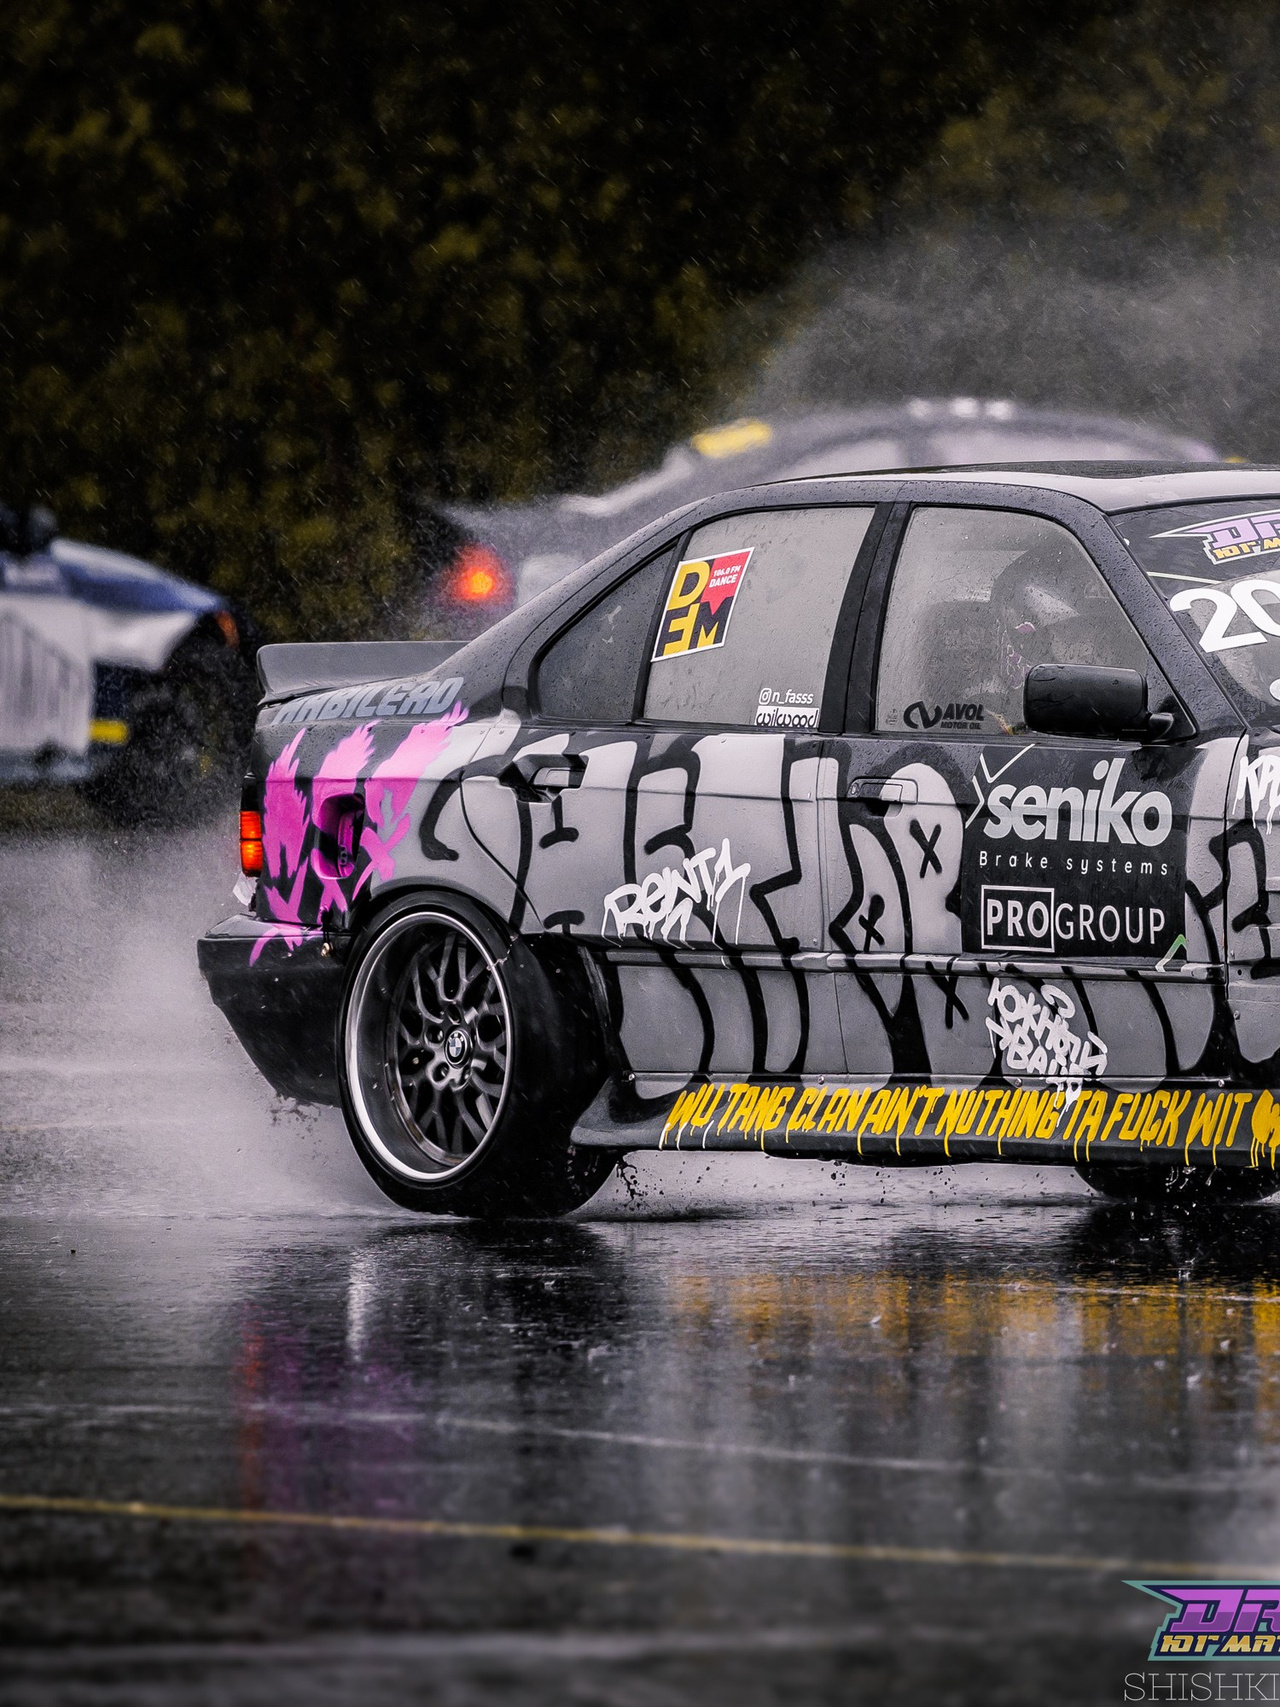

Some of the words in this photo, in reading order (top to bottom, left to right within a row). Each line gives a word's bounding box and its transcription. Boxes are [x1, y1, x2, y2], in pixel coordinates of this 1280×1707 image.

[709, 573, 738, 588] DANCE
[756, 708, 819, 727] wilwood
[940, 722, 968, 730] MOTOR
[969, 722, 982, 730] OIL
[984, 758, 1172, 847] seniko
[979, 850, 1048, 869] Brake
[1066, 857, 1168, 876] systems
[665, 1083, 725, 1132] WU
[717, 1083, 795, 1132] TANG
[788, 1086, 871, 1135] CLAN
[1062, 1089, 1109, 1142] TA
[1100, 1090, 1192, 1147] FUCK
[1186, 1091, 1253, 1148] WIT
